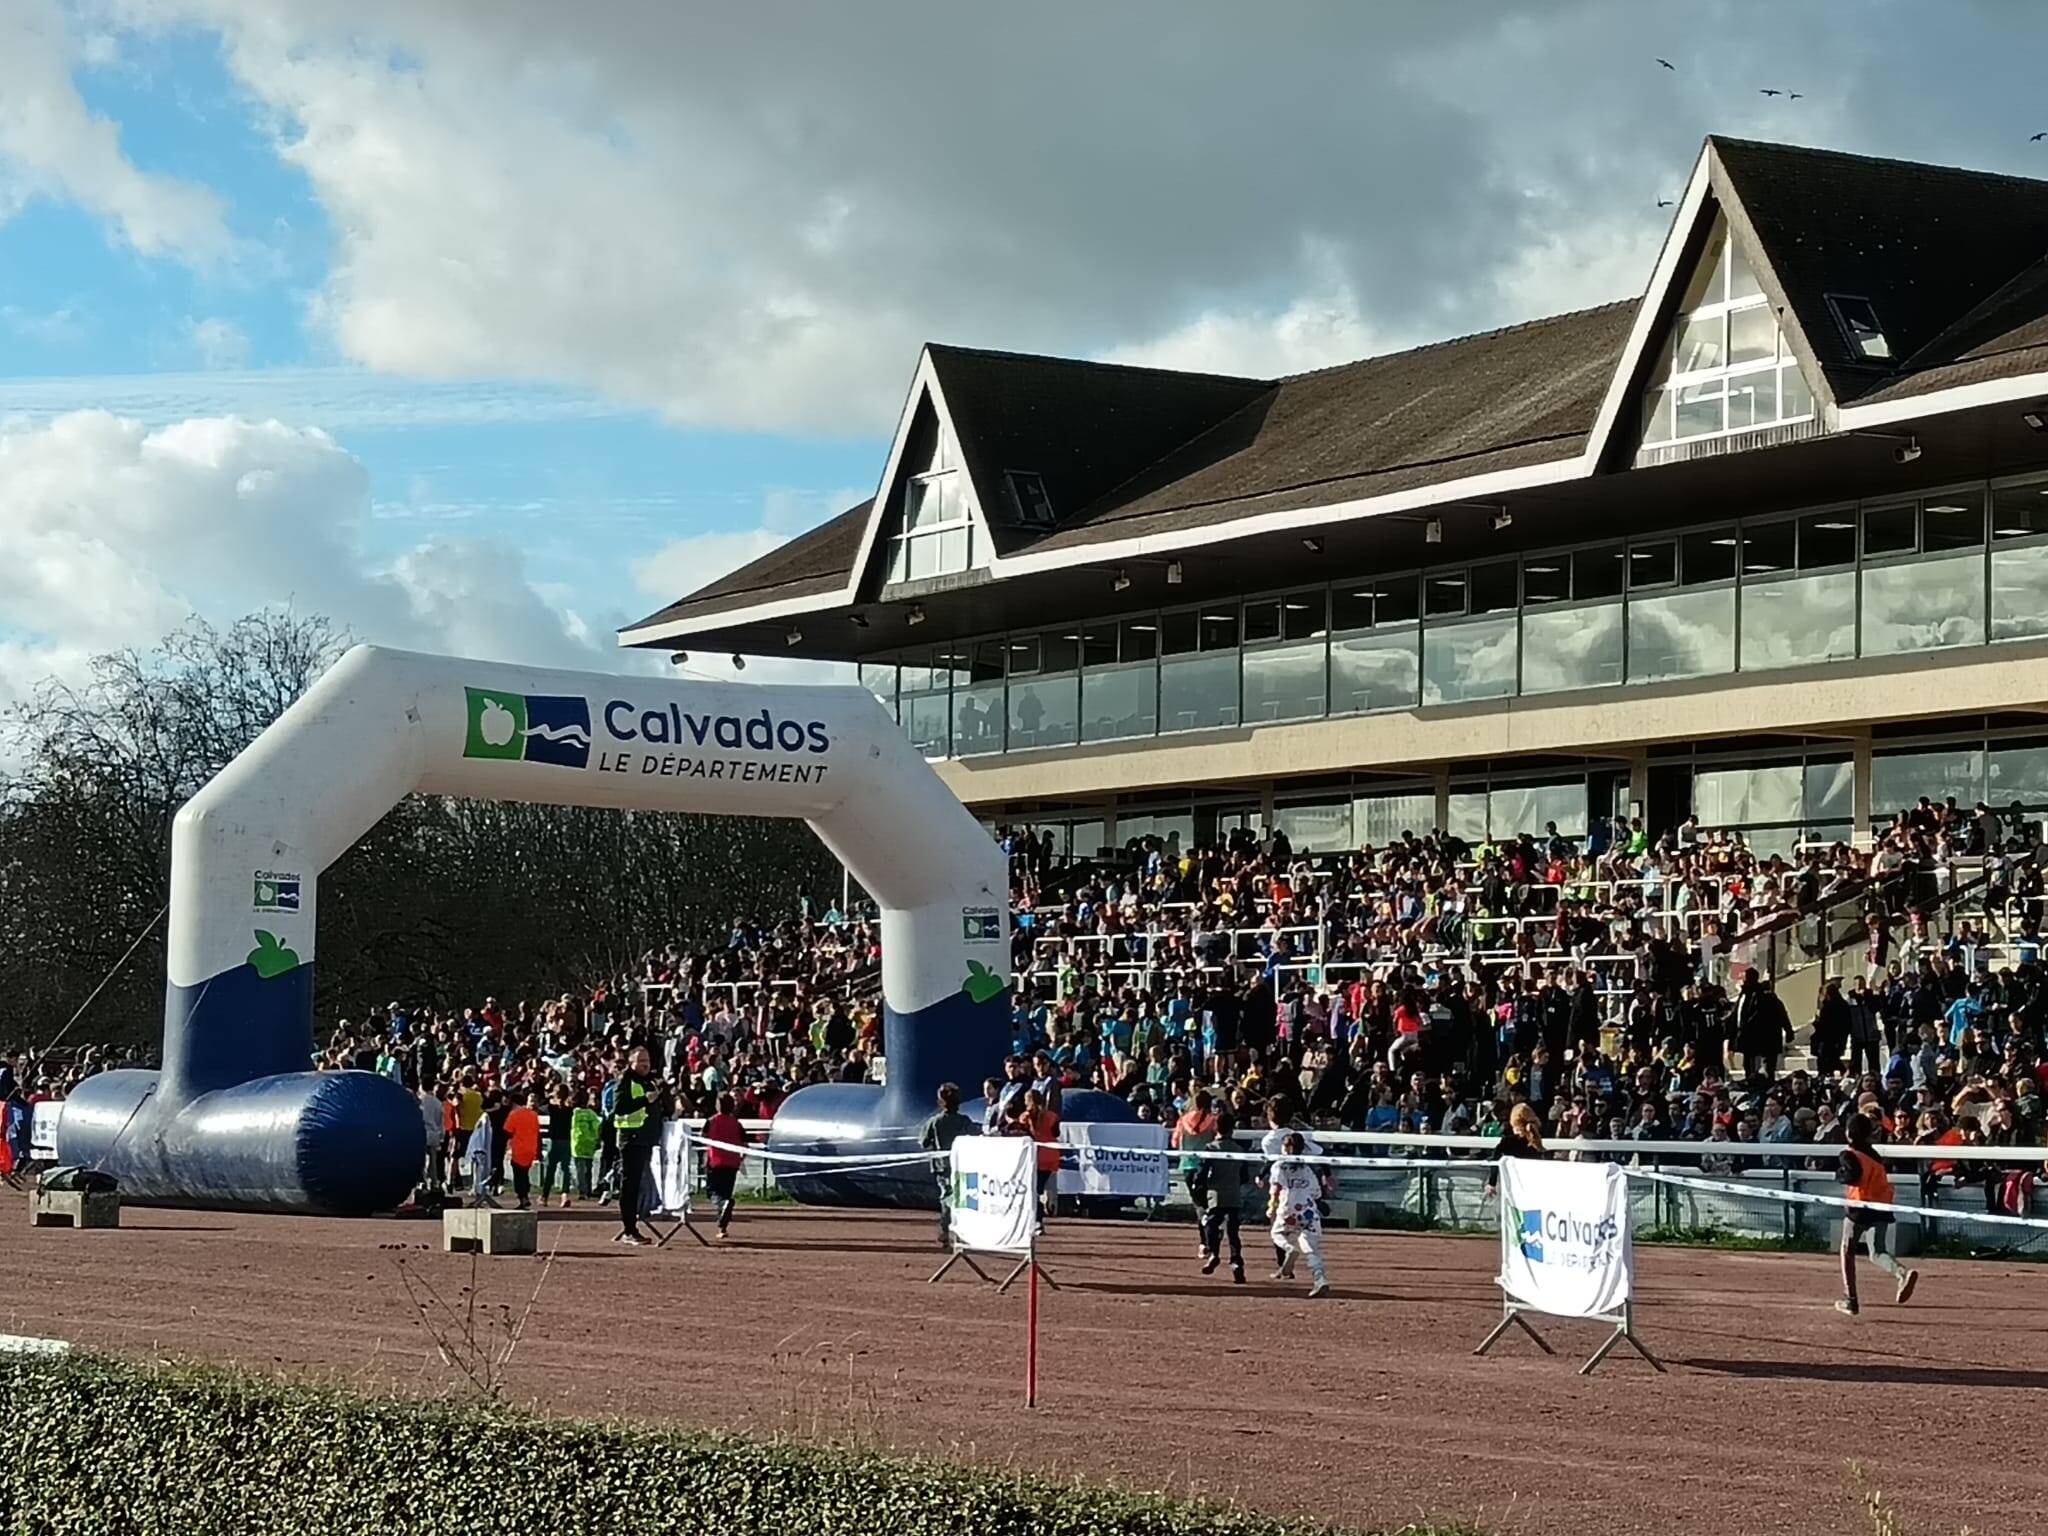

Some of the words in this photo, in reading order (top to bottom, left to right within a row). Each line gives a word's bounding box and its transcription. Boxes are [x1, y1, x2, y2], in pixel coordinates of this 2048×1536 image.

[603, 699, 830, 754] Calvados
[599, 752, 632, 773] LE
[641, 752, 829, 784] DÉPARTEMENT
